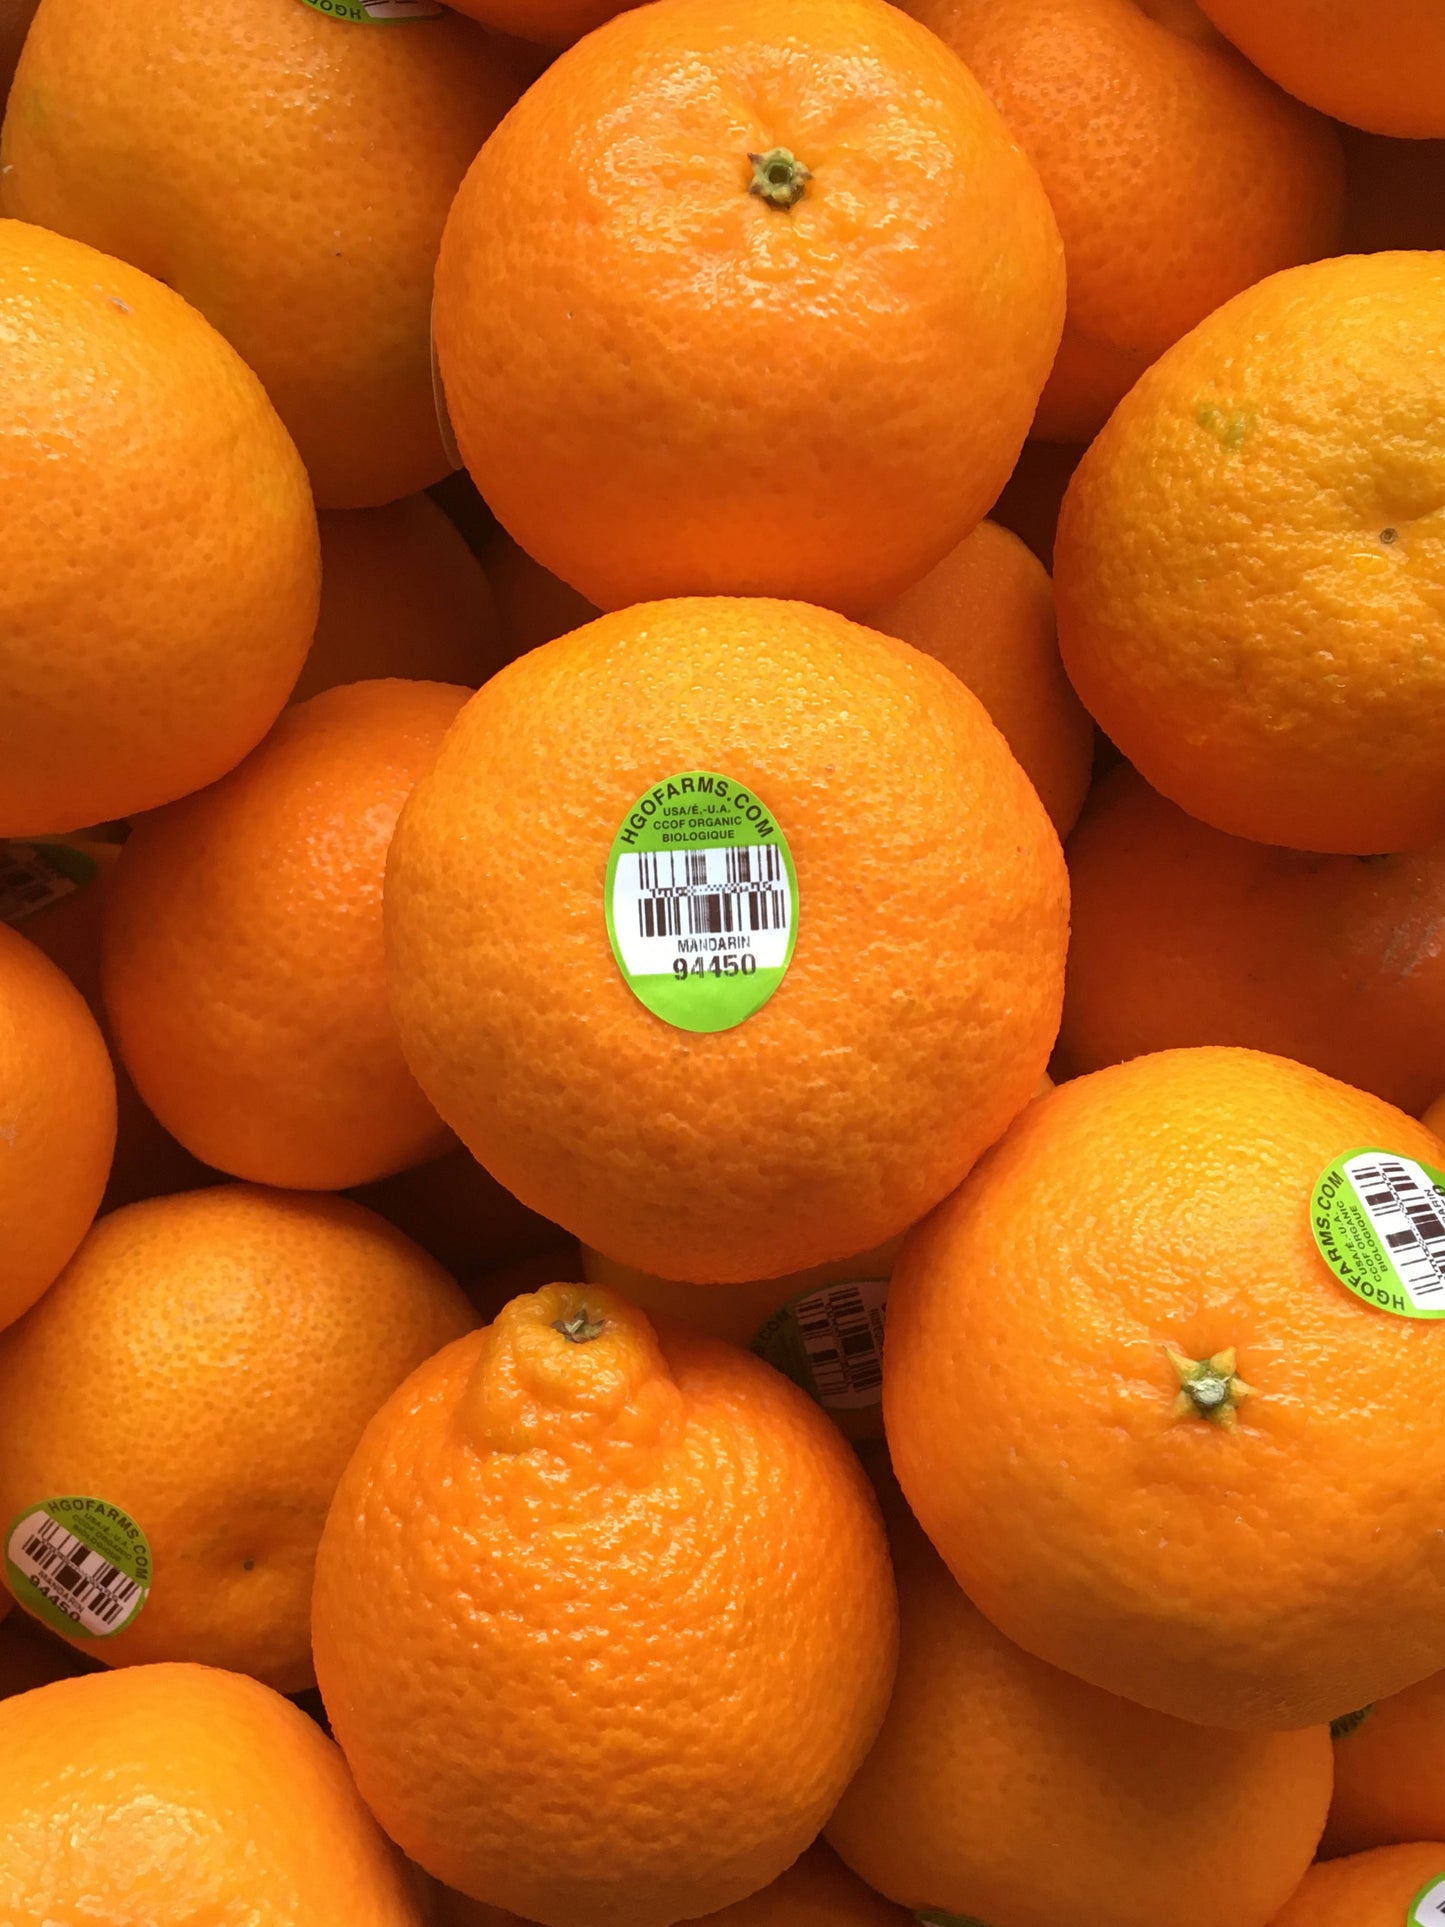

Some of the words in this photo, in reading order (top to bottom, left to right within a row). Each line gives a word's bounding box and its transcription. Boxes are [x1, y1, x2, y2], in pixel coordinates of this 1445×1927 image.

[620, 776, 774, 845] HGOFARMS.COM
[653, 821, 686, 831] CCOF
[688, 816, 742, 828] ORGANIC
[662, 829, 735, 842] BIOLOGIQUE
[673, 953, 757, 981] 94450
[677, 935, 751, 954] MANDARIN
[1316, 1170, 1405, 1310] HGOFARMS.COM
[1336, 1200, 1368, 1251] ORGANIC
[1349, 1205, 1388, 1273] BIOLOGIQUE
[1362, 1253, 1382, 1283] CCOF
[47, 1498, 149, 1581] HGOFARMS.COM
[29, 1574, 81, 1623] 94450
[38, 1570, 85, 1613] MANDARIN
